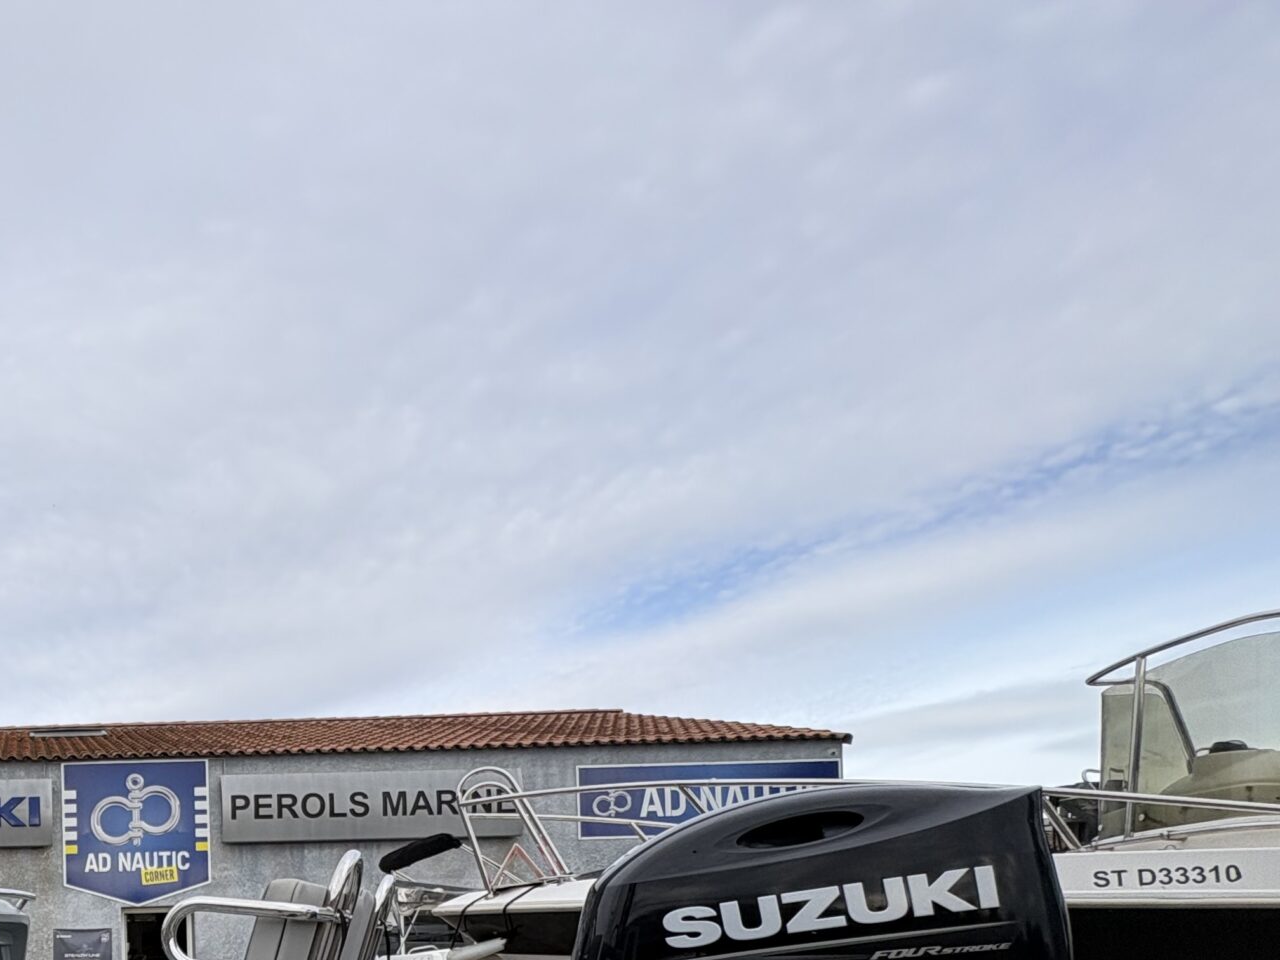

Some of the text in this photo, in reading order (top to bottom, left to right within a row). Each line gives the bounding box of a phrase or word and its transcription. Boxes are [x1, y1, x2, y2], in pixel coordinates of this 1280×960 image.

[230, 787, 516, 820] PEROLS MARNE
[639, 785, 687, 818] AD
[84, 850, 191, 873] AD NAUTIC
[144, 869, 176, 883] CORNER
[1093, 864, 1243, 888] ST D33310
[662, 864, 1001, 950] SUZUKI
